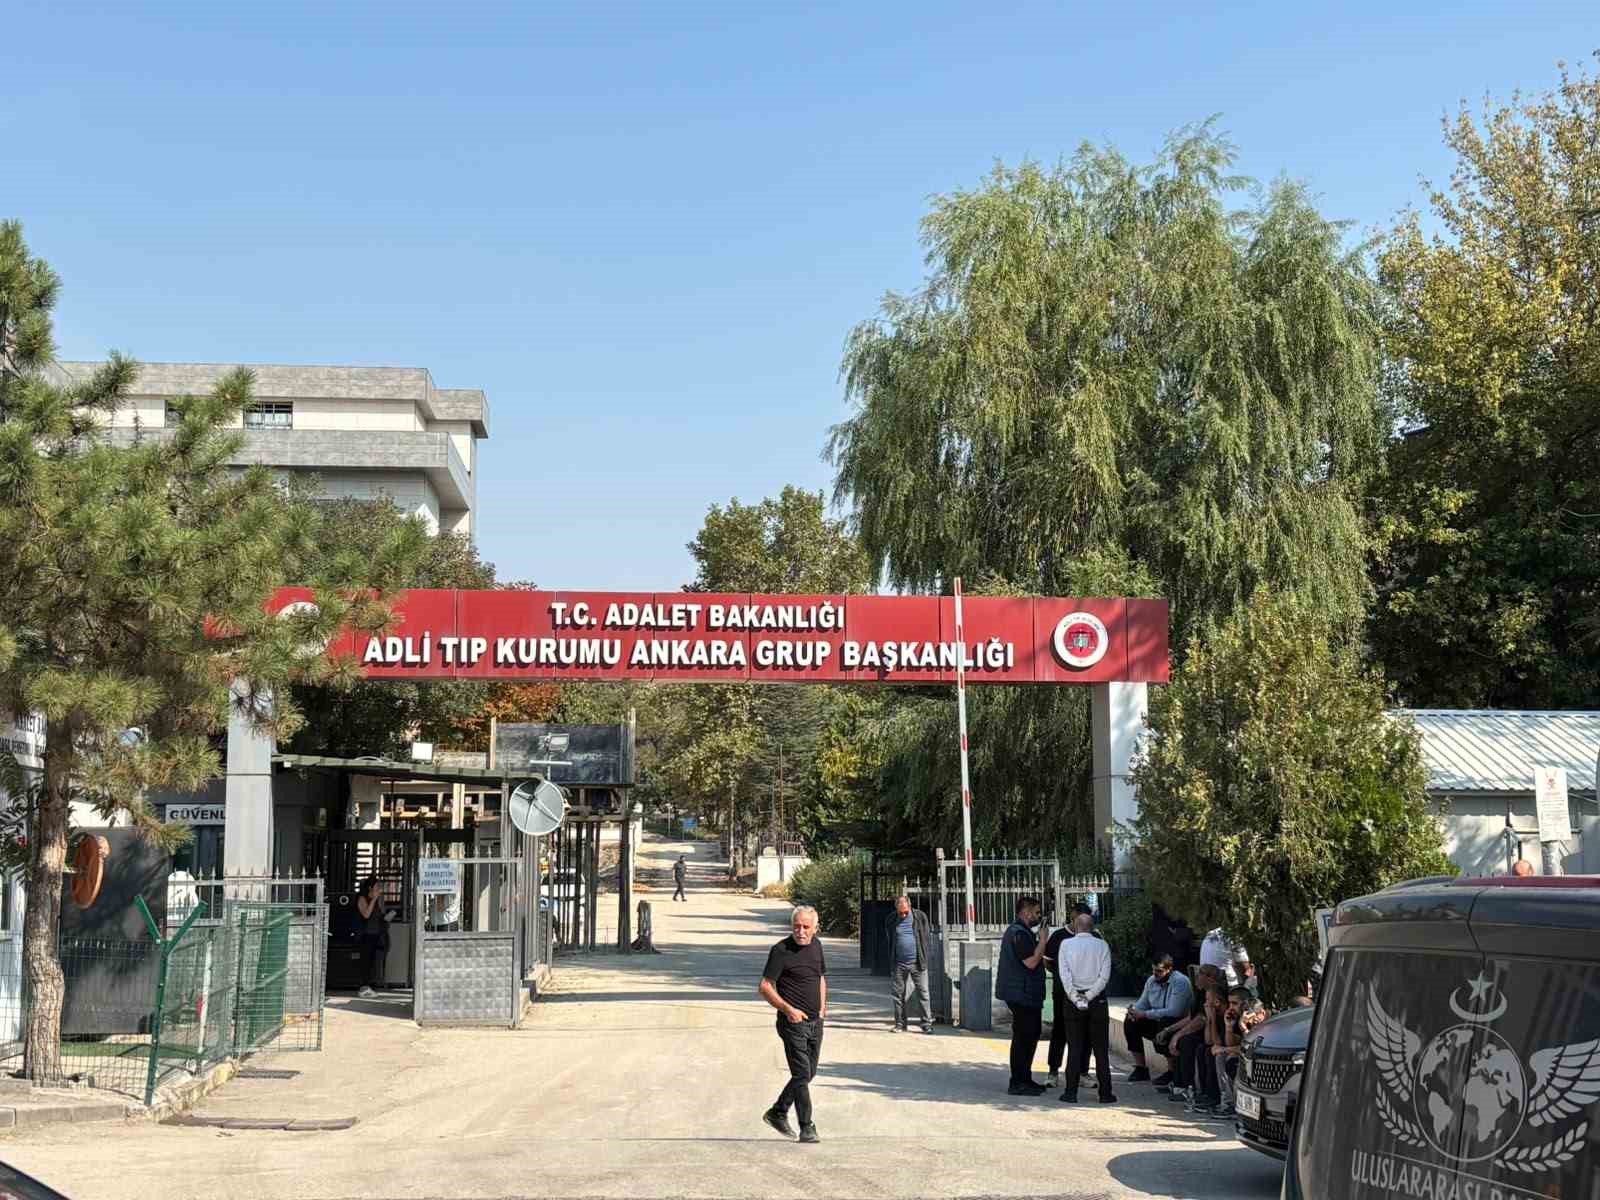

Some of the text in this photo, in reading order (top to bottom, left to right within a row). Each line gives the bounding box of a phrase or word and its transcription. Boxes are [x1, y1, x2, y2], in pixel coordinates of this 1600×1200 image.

[551, 600, 844, 628] T.C. ADALET BAKANLIĞI
[364, 631, 1014, 672] ADLİ TIP KURUMU ANKARA GRUP BAŞKANLIĞI
[1351, 1149, 1481, 1200] ULUSLARARASI
